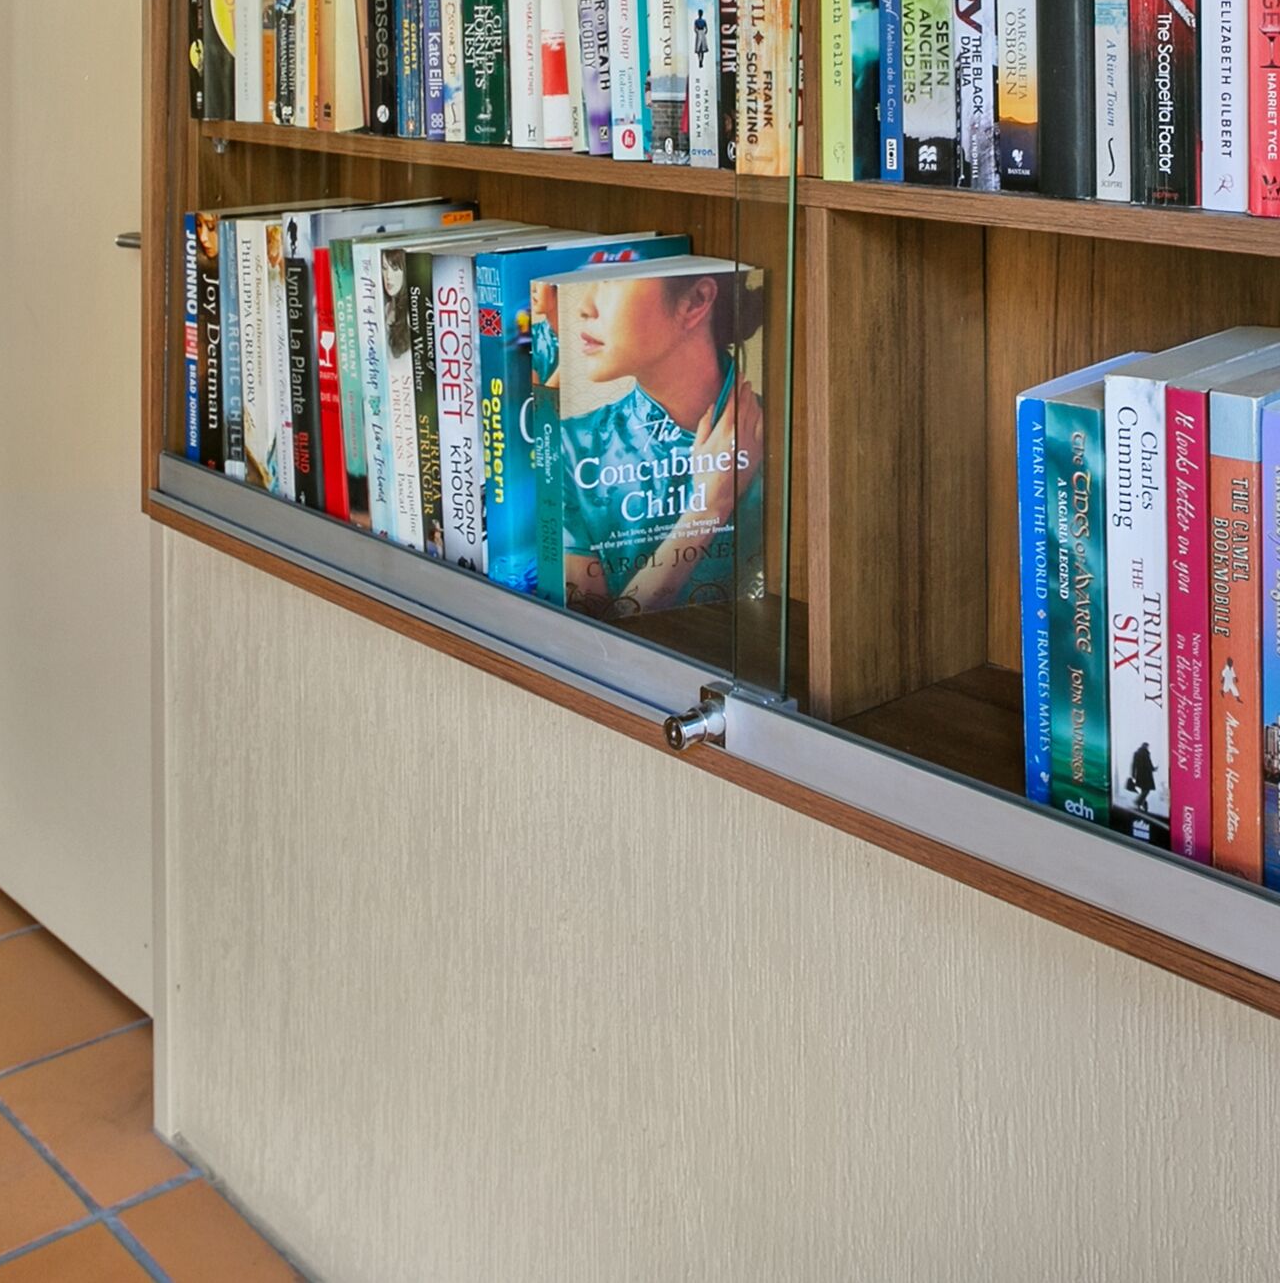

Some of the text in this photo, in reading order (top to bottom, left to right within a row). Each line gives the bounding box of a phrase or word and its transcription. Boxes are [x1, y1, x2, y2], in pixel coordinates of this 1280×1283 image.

[428, 31, 443, 99] Kate Ellis
[579, 20, 596, 71] CORDY
[902, 1, 917, 105] WONDERS
[919, 7, 934, 101] ANCIENT
[935, 20, 950, 87] SEVEN
[960, 35, 972, 87] DAHLIA
[1219, 0, 1233, 159] ELIZABETH GILBERT
[762, 70, 774, 129] FRANK
[1265, 71, 1279, 161] HARRIET TYCE
[185, 229, 198, 316] JOHNNO
[202, 273, 221, 430] Joy Dettman
[240, 238, 256, 407] PHILIPPA GREGORY
[436, 286, 463, 425] SECRET
[417, 413, 434, 516] STRINGER
[573, 439, 750, 490] Concubine's
[633, 414, 683, 452] The
[1111, 405, 1139, 530] Cumming
[1139, 430, 1159, 511] Charles
[449, 444, 465, 537] KHOURY
[461, 436, 476, 546] RAYMOND
[620, 483, 708, 522] Child
[1231, 477, 1250, 583] THE CAMEL
[1130, 557, 1144, 589] THE
[1211, 516, 1230, 638] BOOKMOBILE
[1111, 612, 1140, 675] SIX
[1141, 590, 1163, 710] TRINITY
[1036, 628, 1051, 753] FRANCES MAYES
